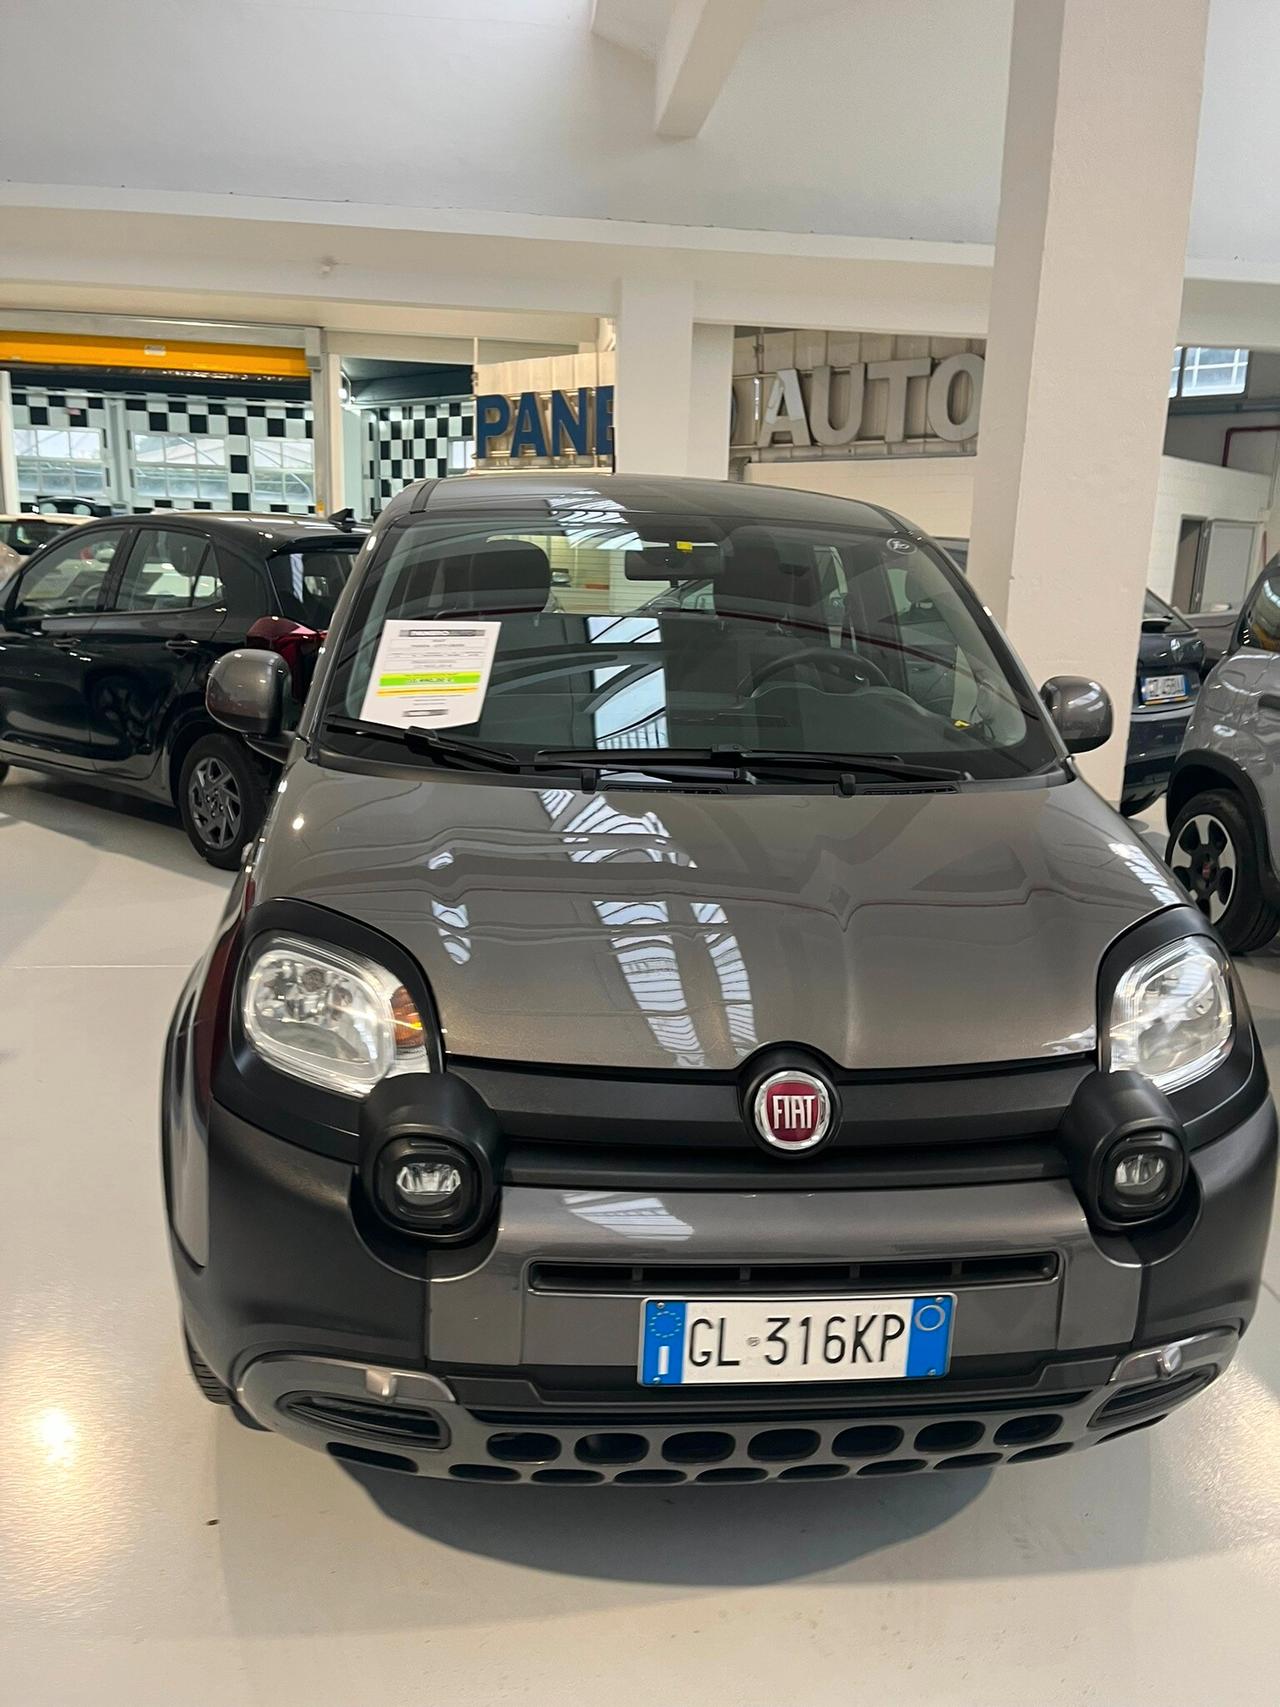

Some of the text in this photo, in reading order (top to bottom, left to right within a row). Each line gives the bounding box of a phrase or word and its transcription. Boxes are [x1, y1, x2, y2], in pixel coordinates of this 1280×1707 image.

[757, 353, 985, 447] AUTO
[772, 1095, 817, 1130] FIAT
[688, 1313, 906, 1367] GL 316KP
